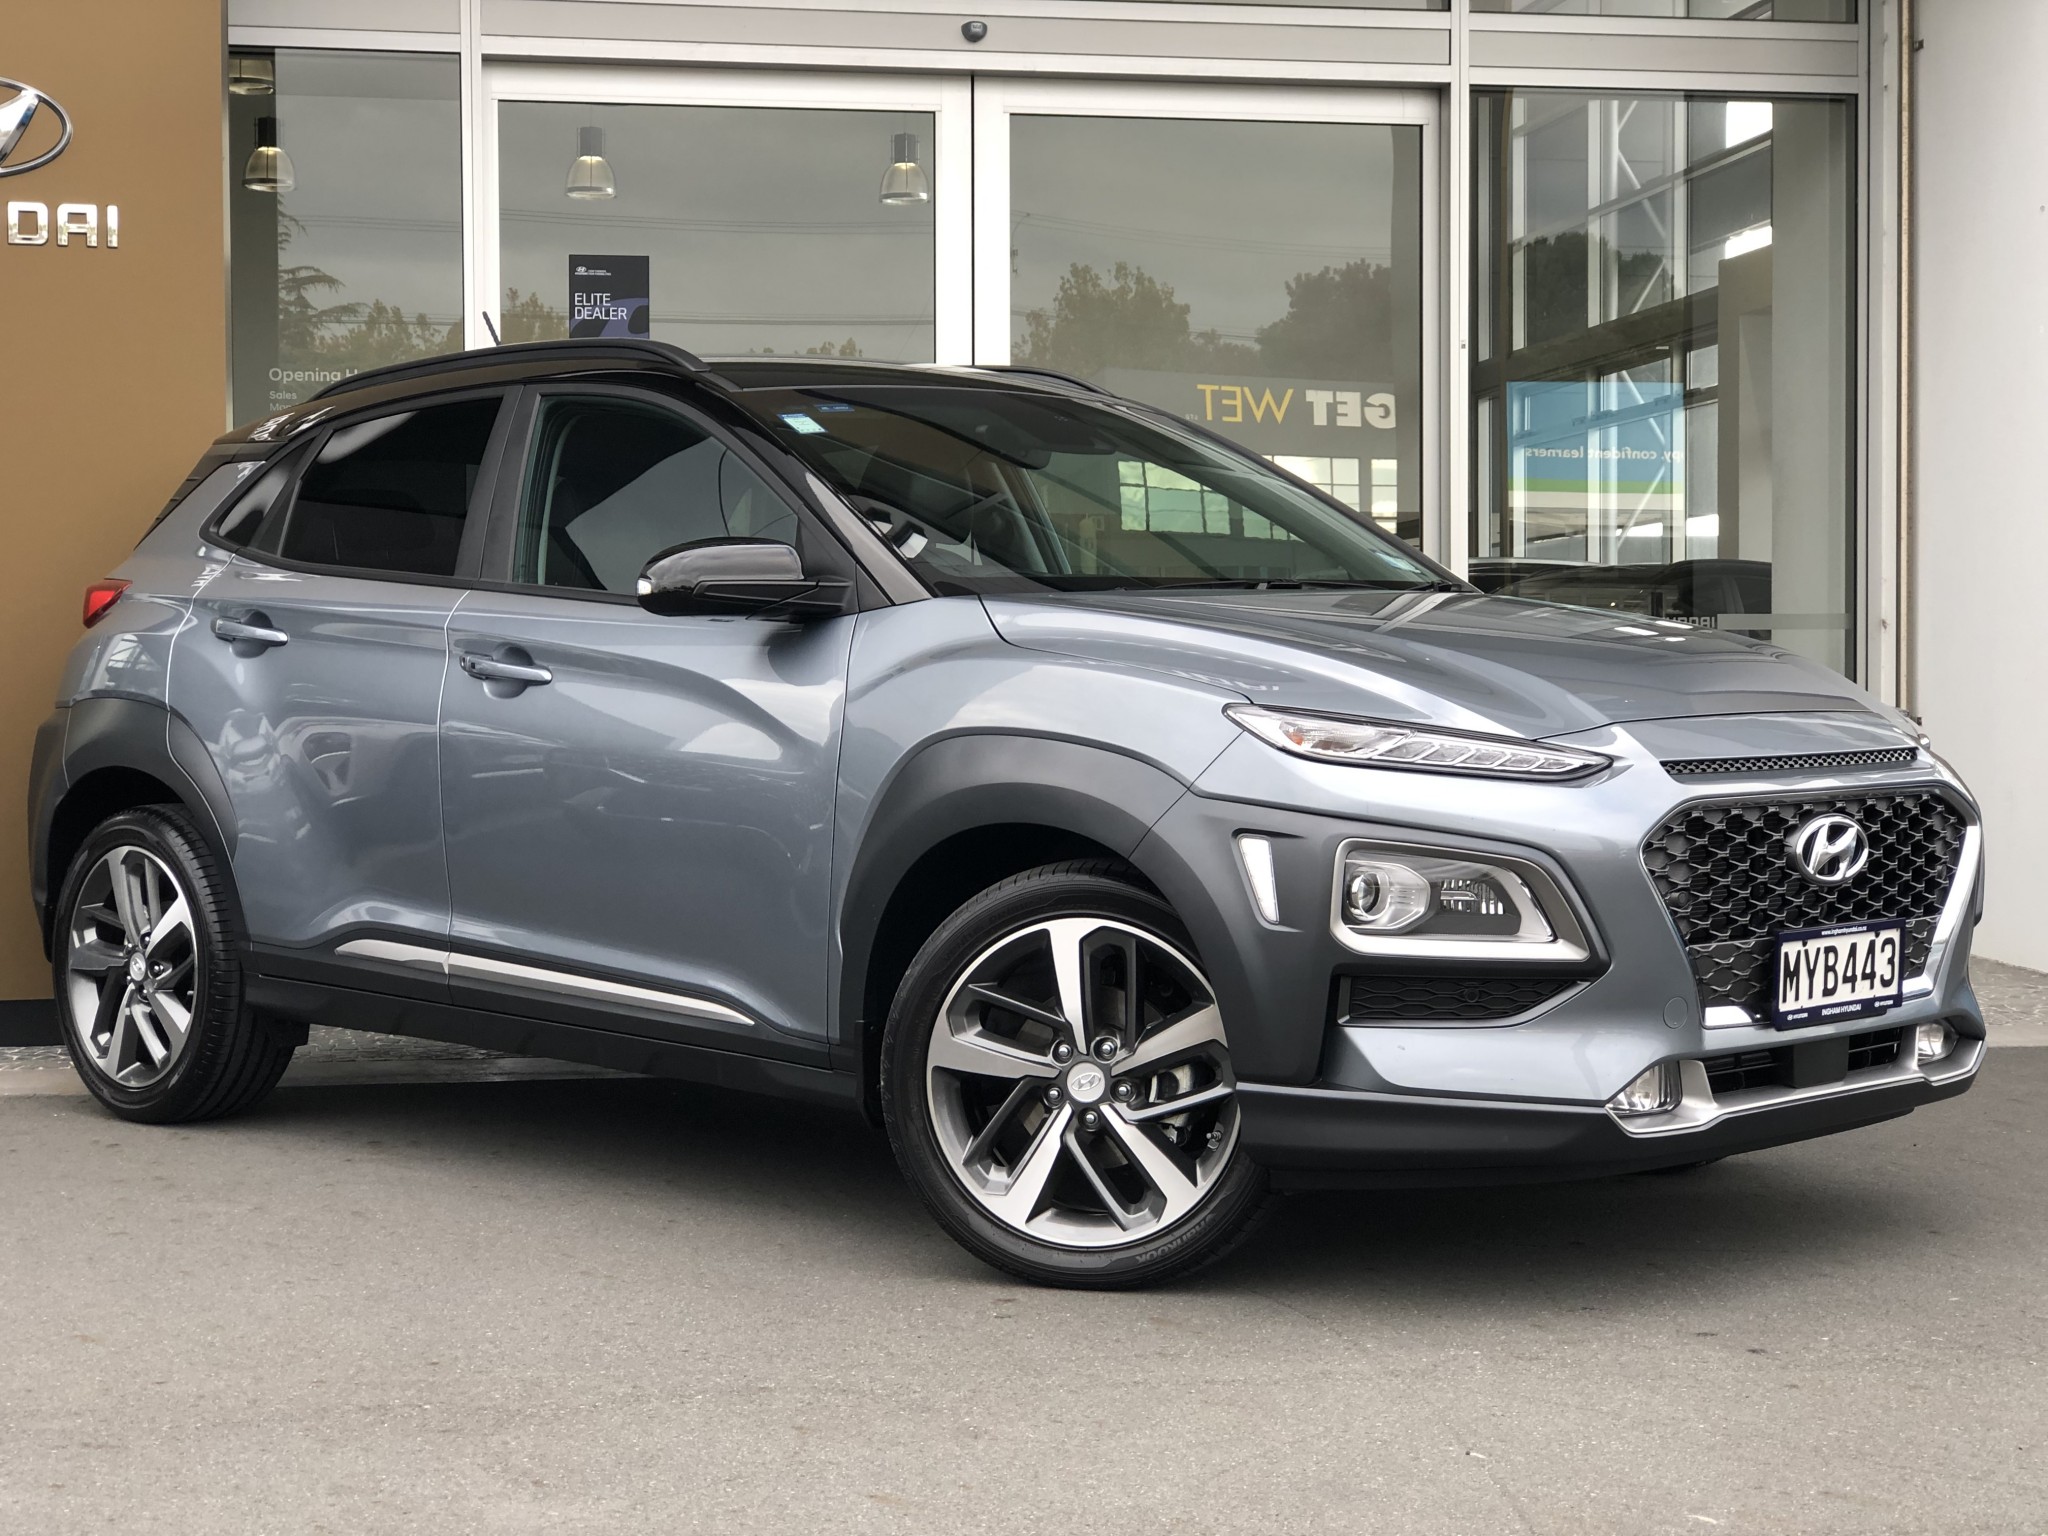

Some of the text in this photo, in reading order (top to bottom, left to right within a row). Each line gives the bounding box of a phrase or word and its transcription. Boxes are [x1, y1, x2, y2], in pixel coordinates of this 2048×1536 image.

[574, 293, 611, 306] ELITE
[574, 307, 628, 320] DEALER
[269, 368, 341, 383] Opening
[269, 390, 297, 400] Sales
[1782, 937, 1896, 1003] MYB443
[1821, 1003, 1861, 1016] INGHAM HYUNDAI
